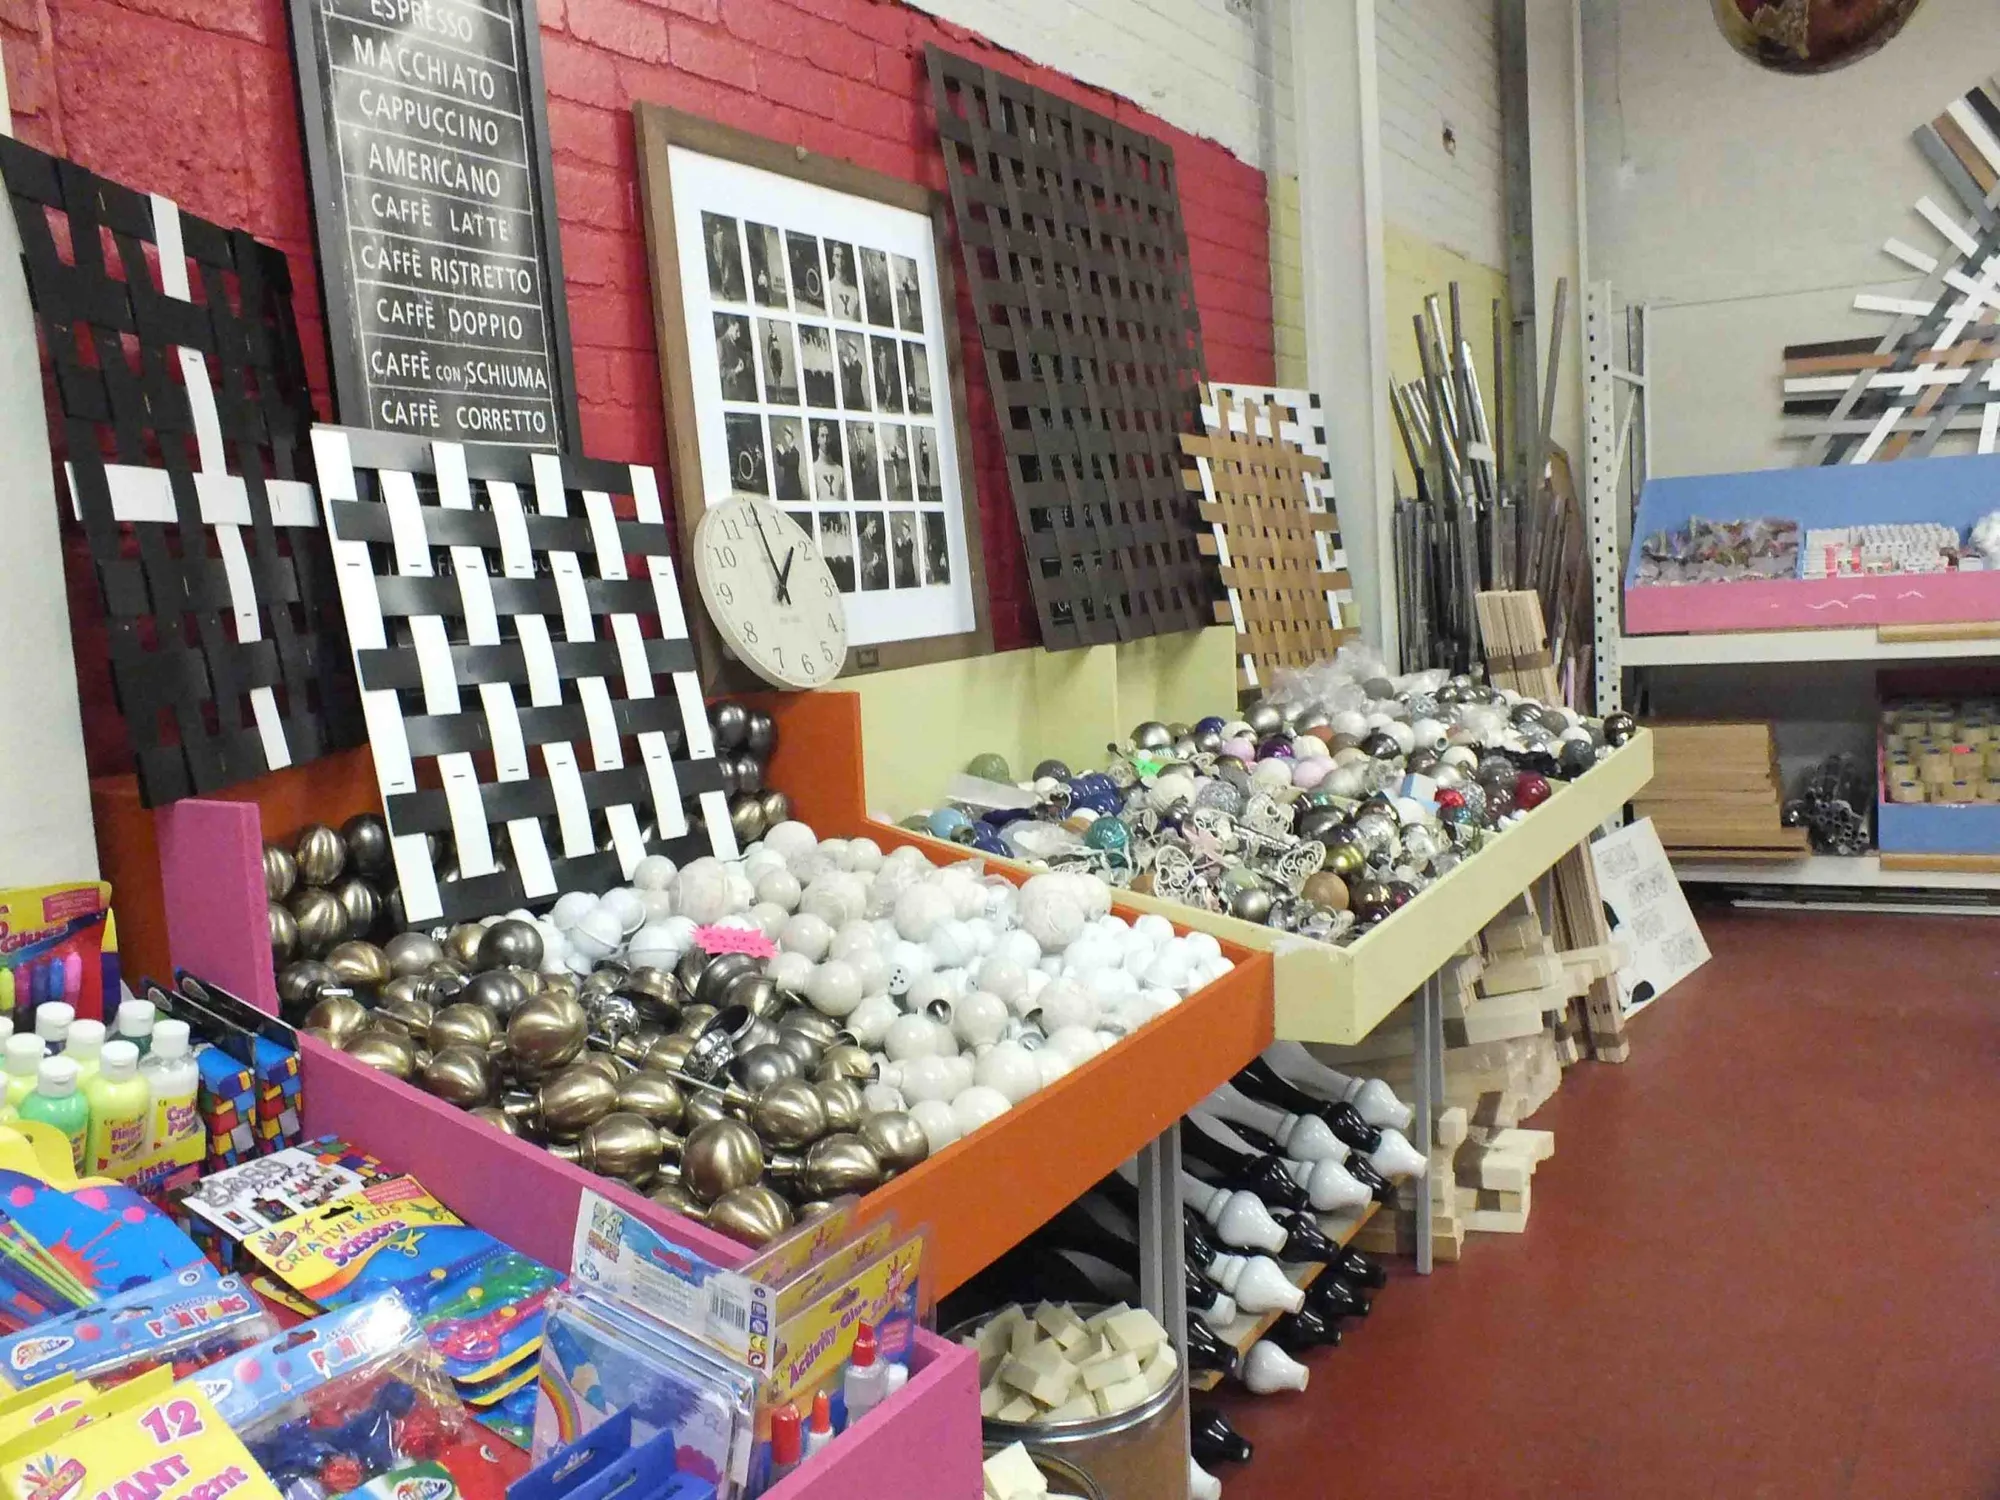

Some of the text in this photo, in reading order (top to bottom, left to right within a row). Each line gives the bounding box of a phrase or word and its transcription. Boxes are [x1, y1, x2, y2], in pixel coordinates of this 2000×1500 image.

[371, 0, 472, 42] ESPRESSO
[352, 34, 494, 99] MACCHIATO
[359, 89, 498, 146] CAPPUCCINO
[368, 143, 500, 197] AMERICANO
[450, 209, 509, 242] LATTE
[430, 257, 531, 295] RISTRETTO
[449, 309, 523, 340] DOPPIO
[466, 362, 546, 390] SCHIUMA
[456, 406, 546, 433] CORRETTO
[720, 518, 744, 541] 11
[772, 515, 784, 535] 1
[713, 546, 737, 569] 10
[798, 540, 812, 561] 2
[719, 582, 734, 605] 9
[820, 576, 833, 597] 3
[743, 621, 758, 643] 8
[828, 612, 838, 633] 4
[772, 647, 785, 669] 7
[801, 653, 815, 675] 6
[819, 641, 834, 662] 5
[275, 1218, 357, 1273] CREATIVE
[352, 1203, 402, 1224] KIDS
[788, 1325, 838, 1389] Activity
[141, 1400, 203, 1443] 12
